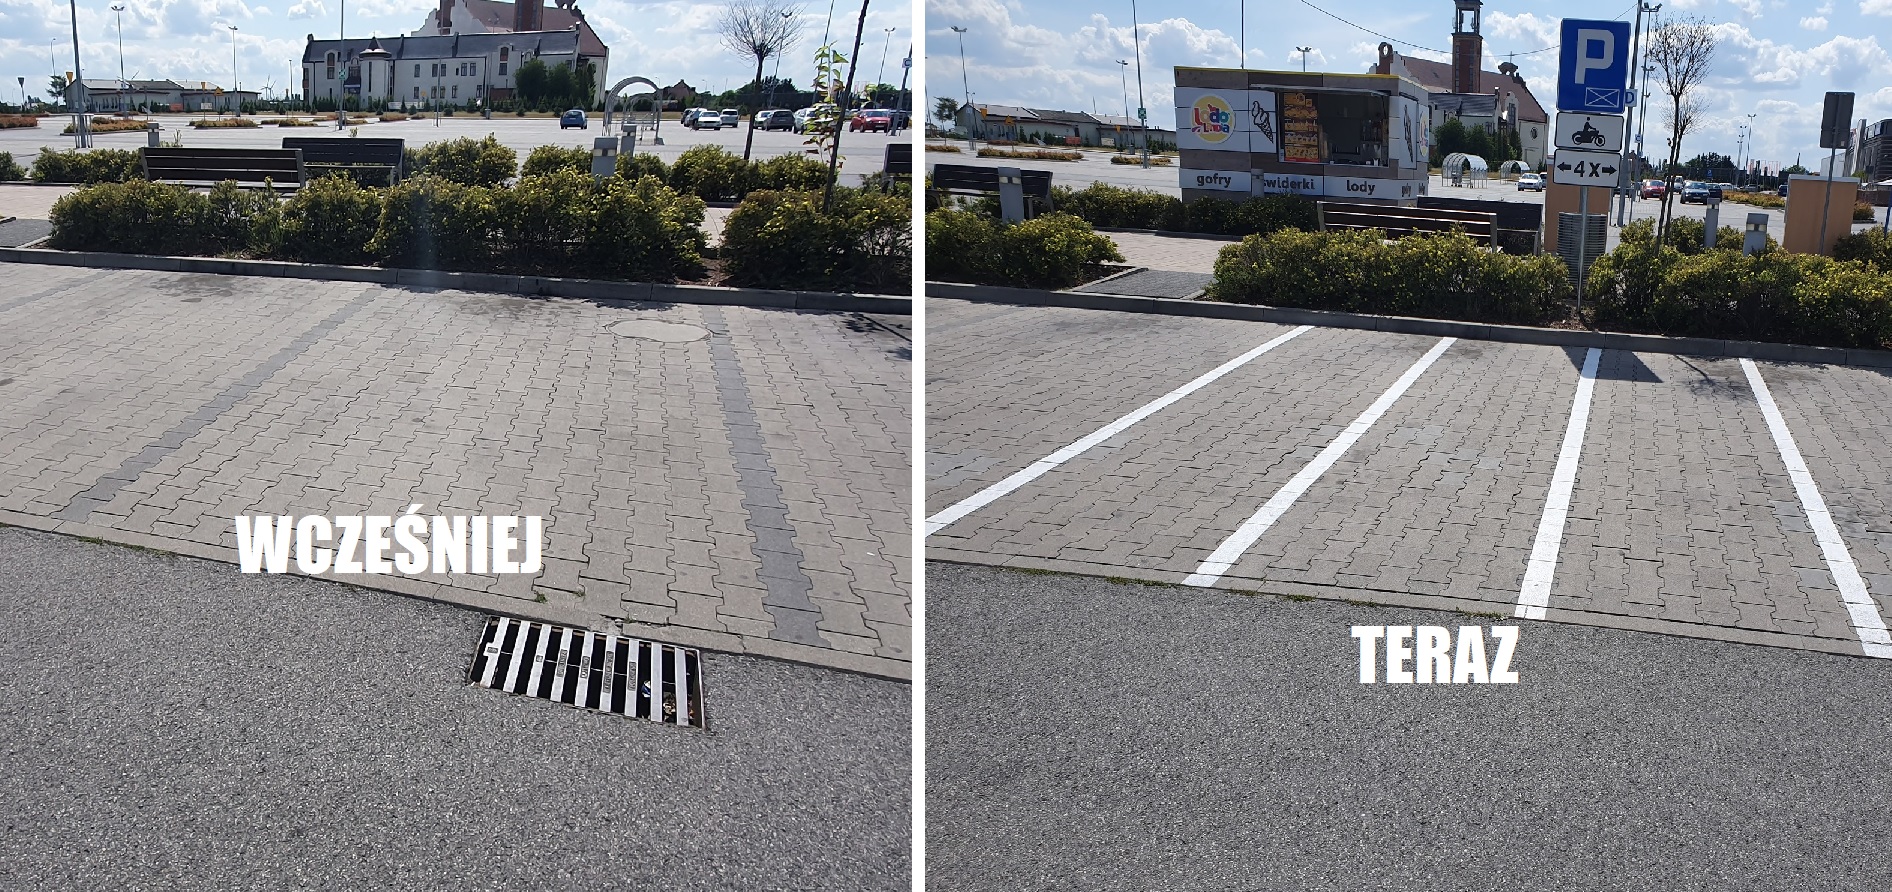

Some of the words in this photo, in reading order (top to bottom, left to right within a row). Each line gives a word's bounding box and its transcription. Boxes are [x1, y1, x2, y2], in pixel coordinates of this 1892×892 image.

[1575, 28, 1615, 85] P
[1196, 172, 1232, 187] gofry
[1346, 179, 1376, 195] lody
